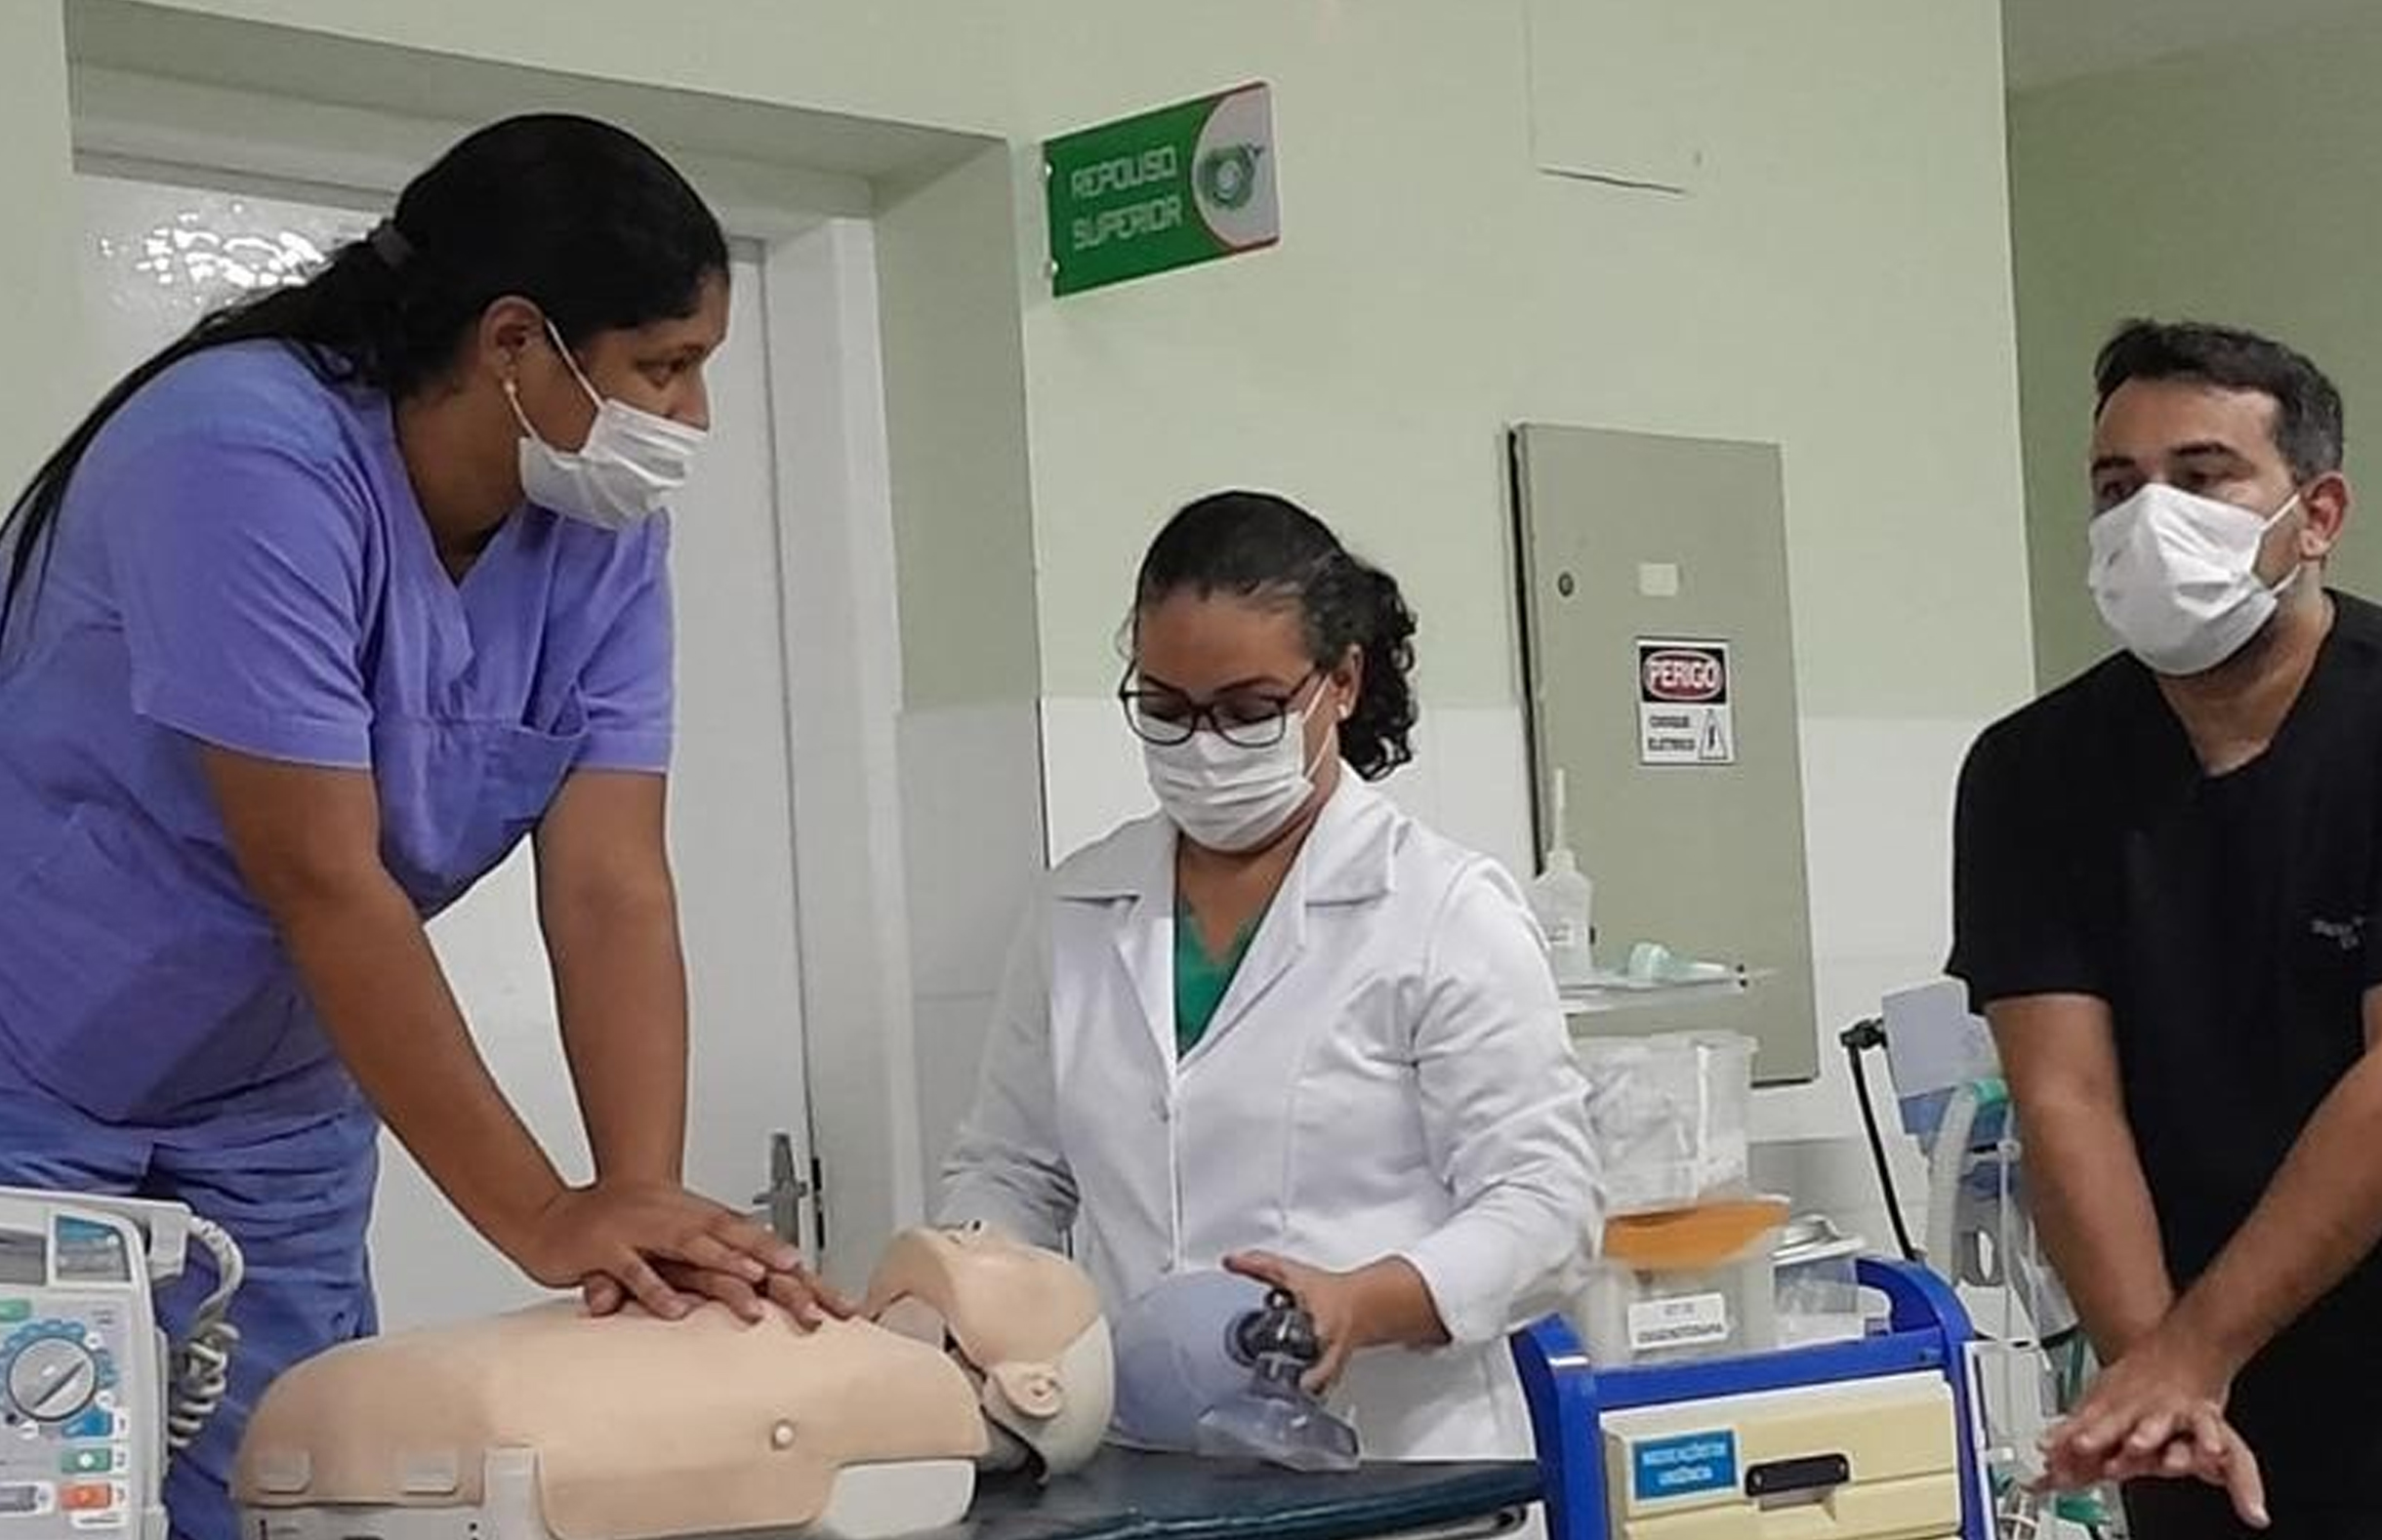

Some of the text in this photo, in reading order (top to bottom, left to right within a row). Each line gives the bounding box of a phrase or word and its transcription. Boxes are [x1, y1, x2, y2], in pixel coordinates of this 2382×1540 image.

[1071, 144, 1177, 198] REPOUSO
[1073, 194, 1183, 251] SUPERIOR
[1650, 660, 1717, 689] PERIGO
